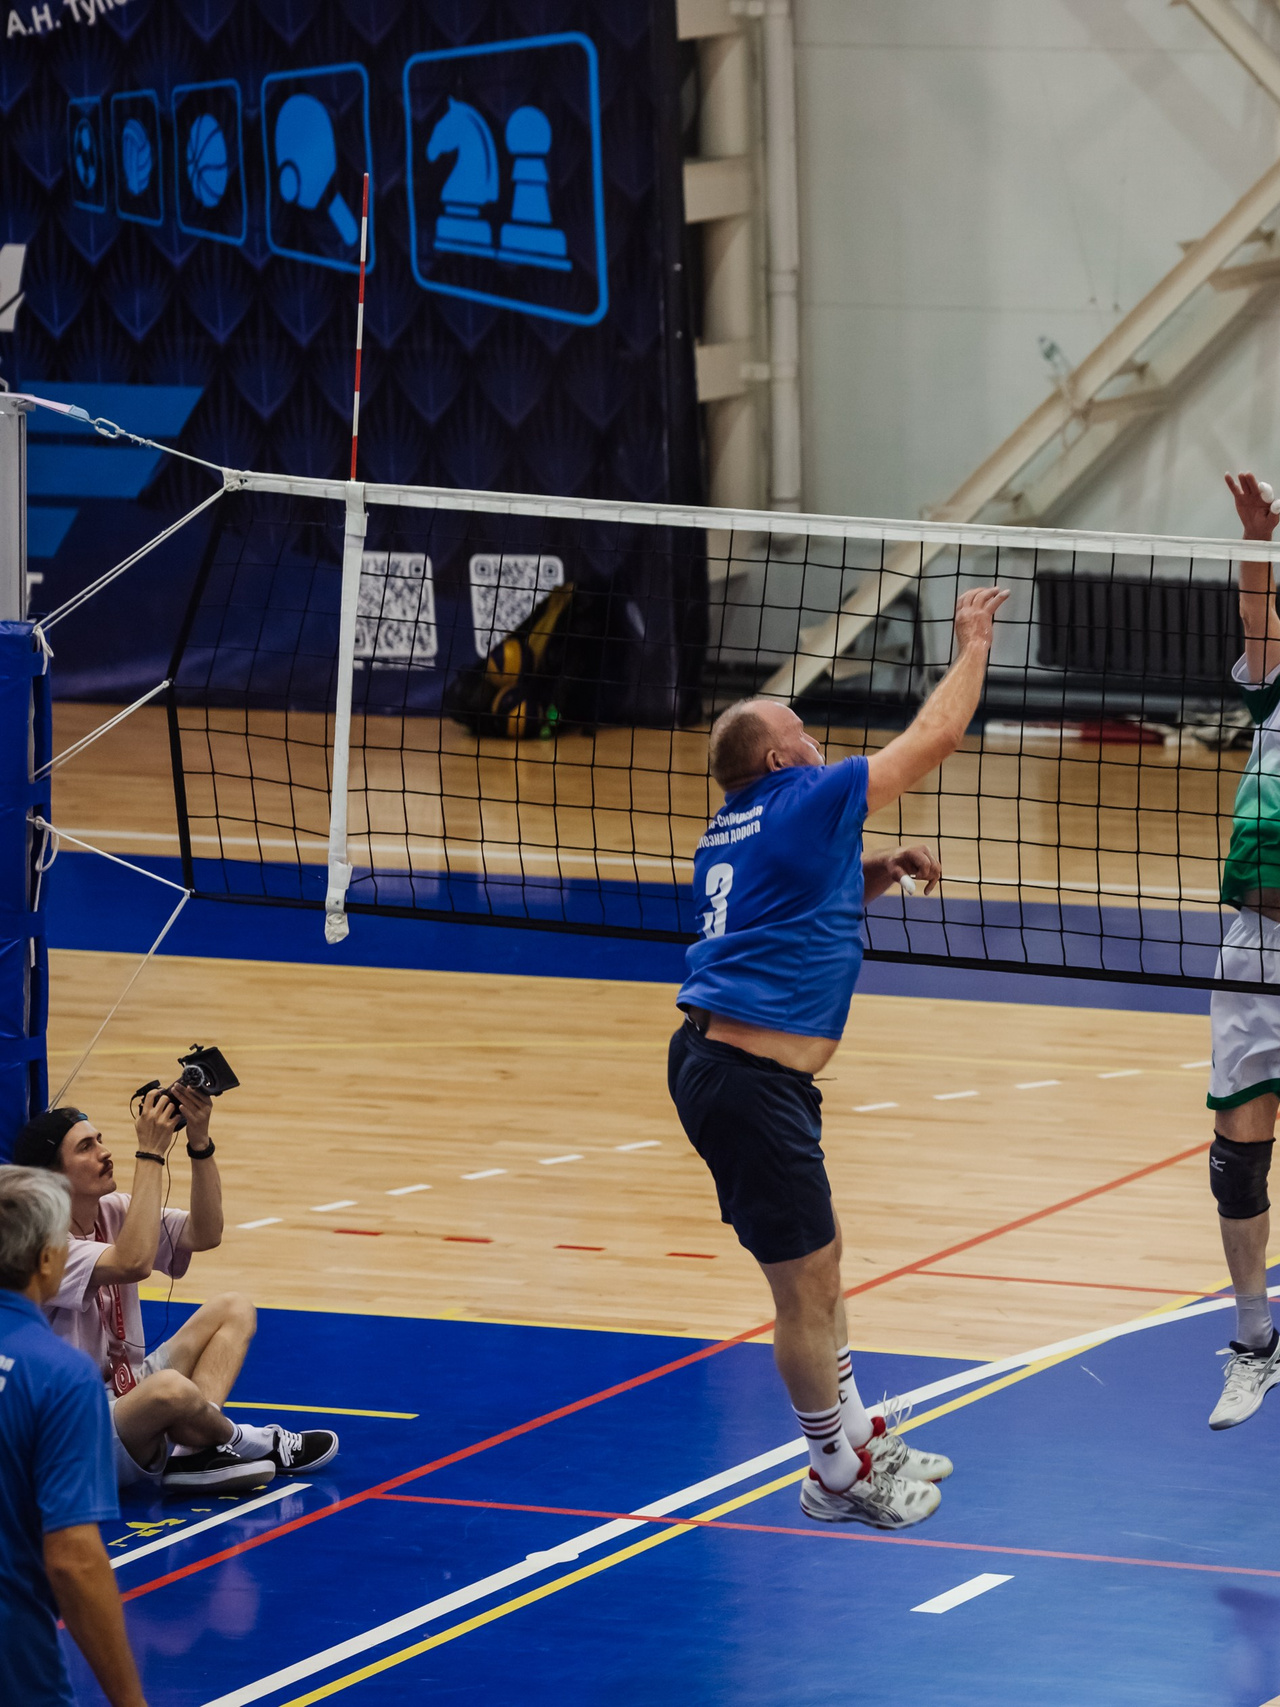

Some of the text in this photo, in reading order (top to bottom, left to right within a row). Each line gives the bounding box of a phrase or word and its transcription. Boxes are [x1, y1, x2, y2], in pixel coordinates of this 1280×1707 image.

[6, 3, 61, 39] А.Н.
[730, 820, 761, 844] дорога
[702, 862, 734, 940] 3
